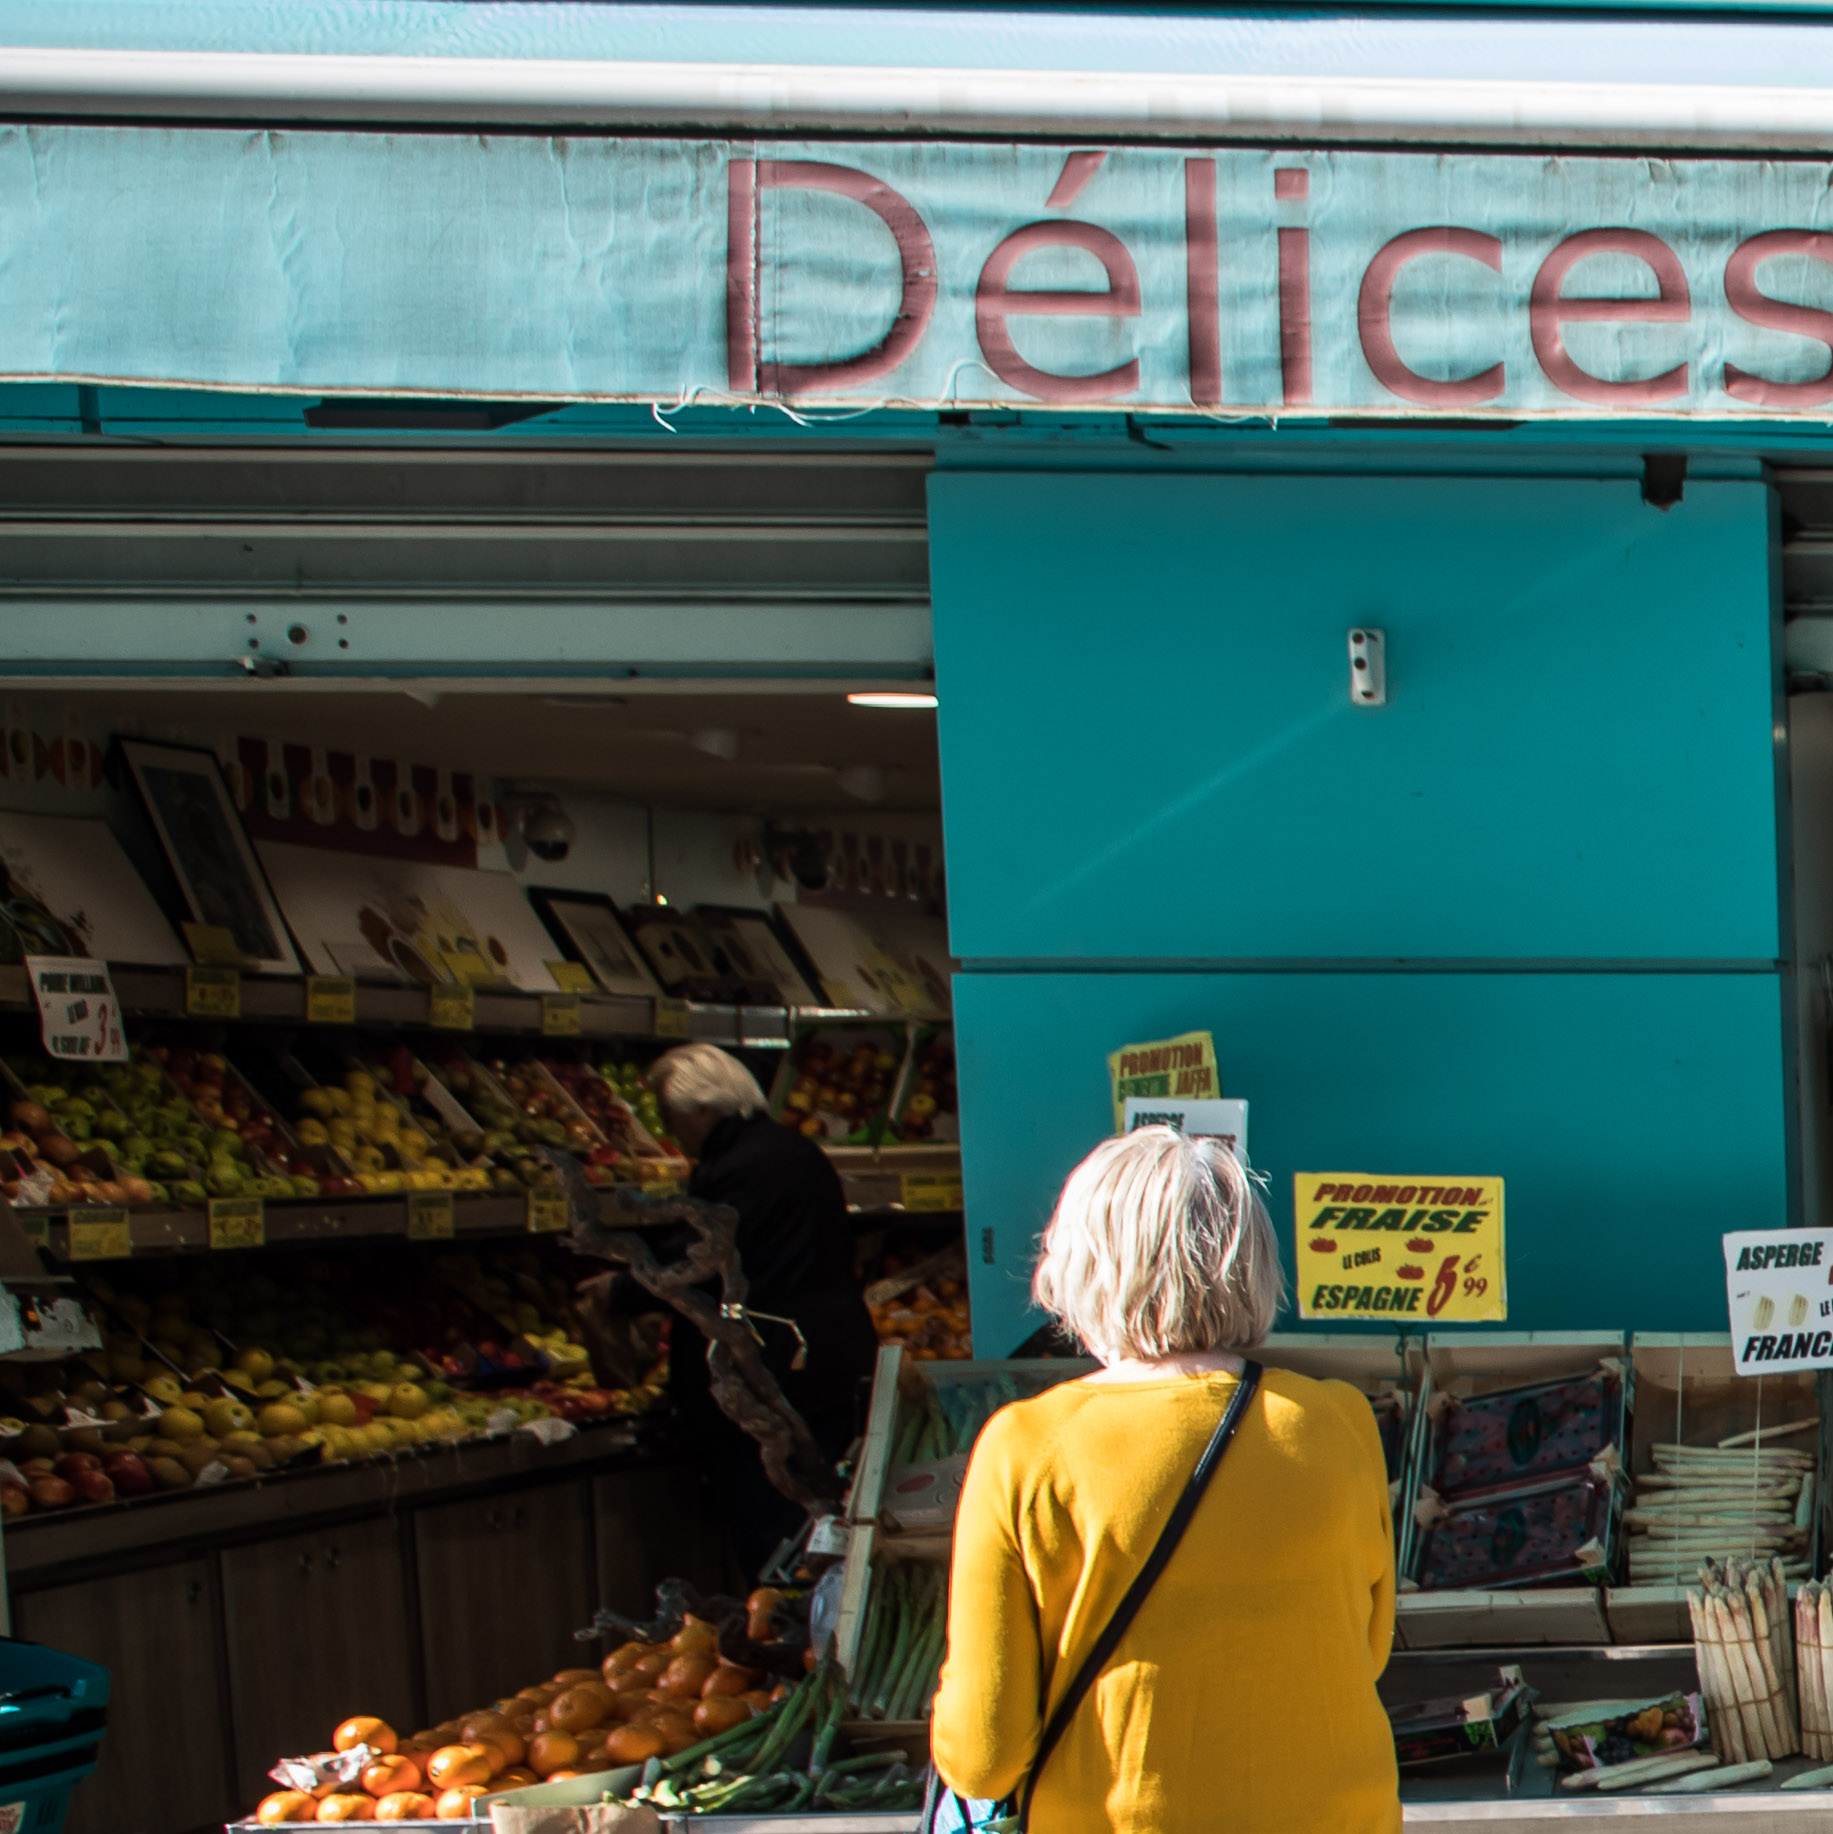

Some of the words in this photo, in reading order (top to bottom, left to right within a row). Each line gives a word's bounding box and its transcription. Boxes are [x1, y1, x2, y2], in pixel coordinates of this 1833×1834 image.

[1119, 1041, 1204, 1078] PROMOTION
[1313, 1182, 1484, 1206] PROMOTION
[1308, 1206, 1490, 1233] FRAISE
[1735, 1241, 1824, 1272] ASPERGE
[1311, 1284, 1424, 1312] ESPAGNE
[1463, 1276, 1488, 1298] 99
[1820, 1301, 1830, 1318] LE
